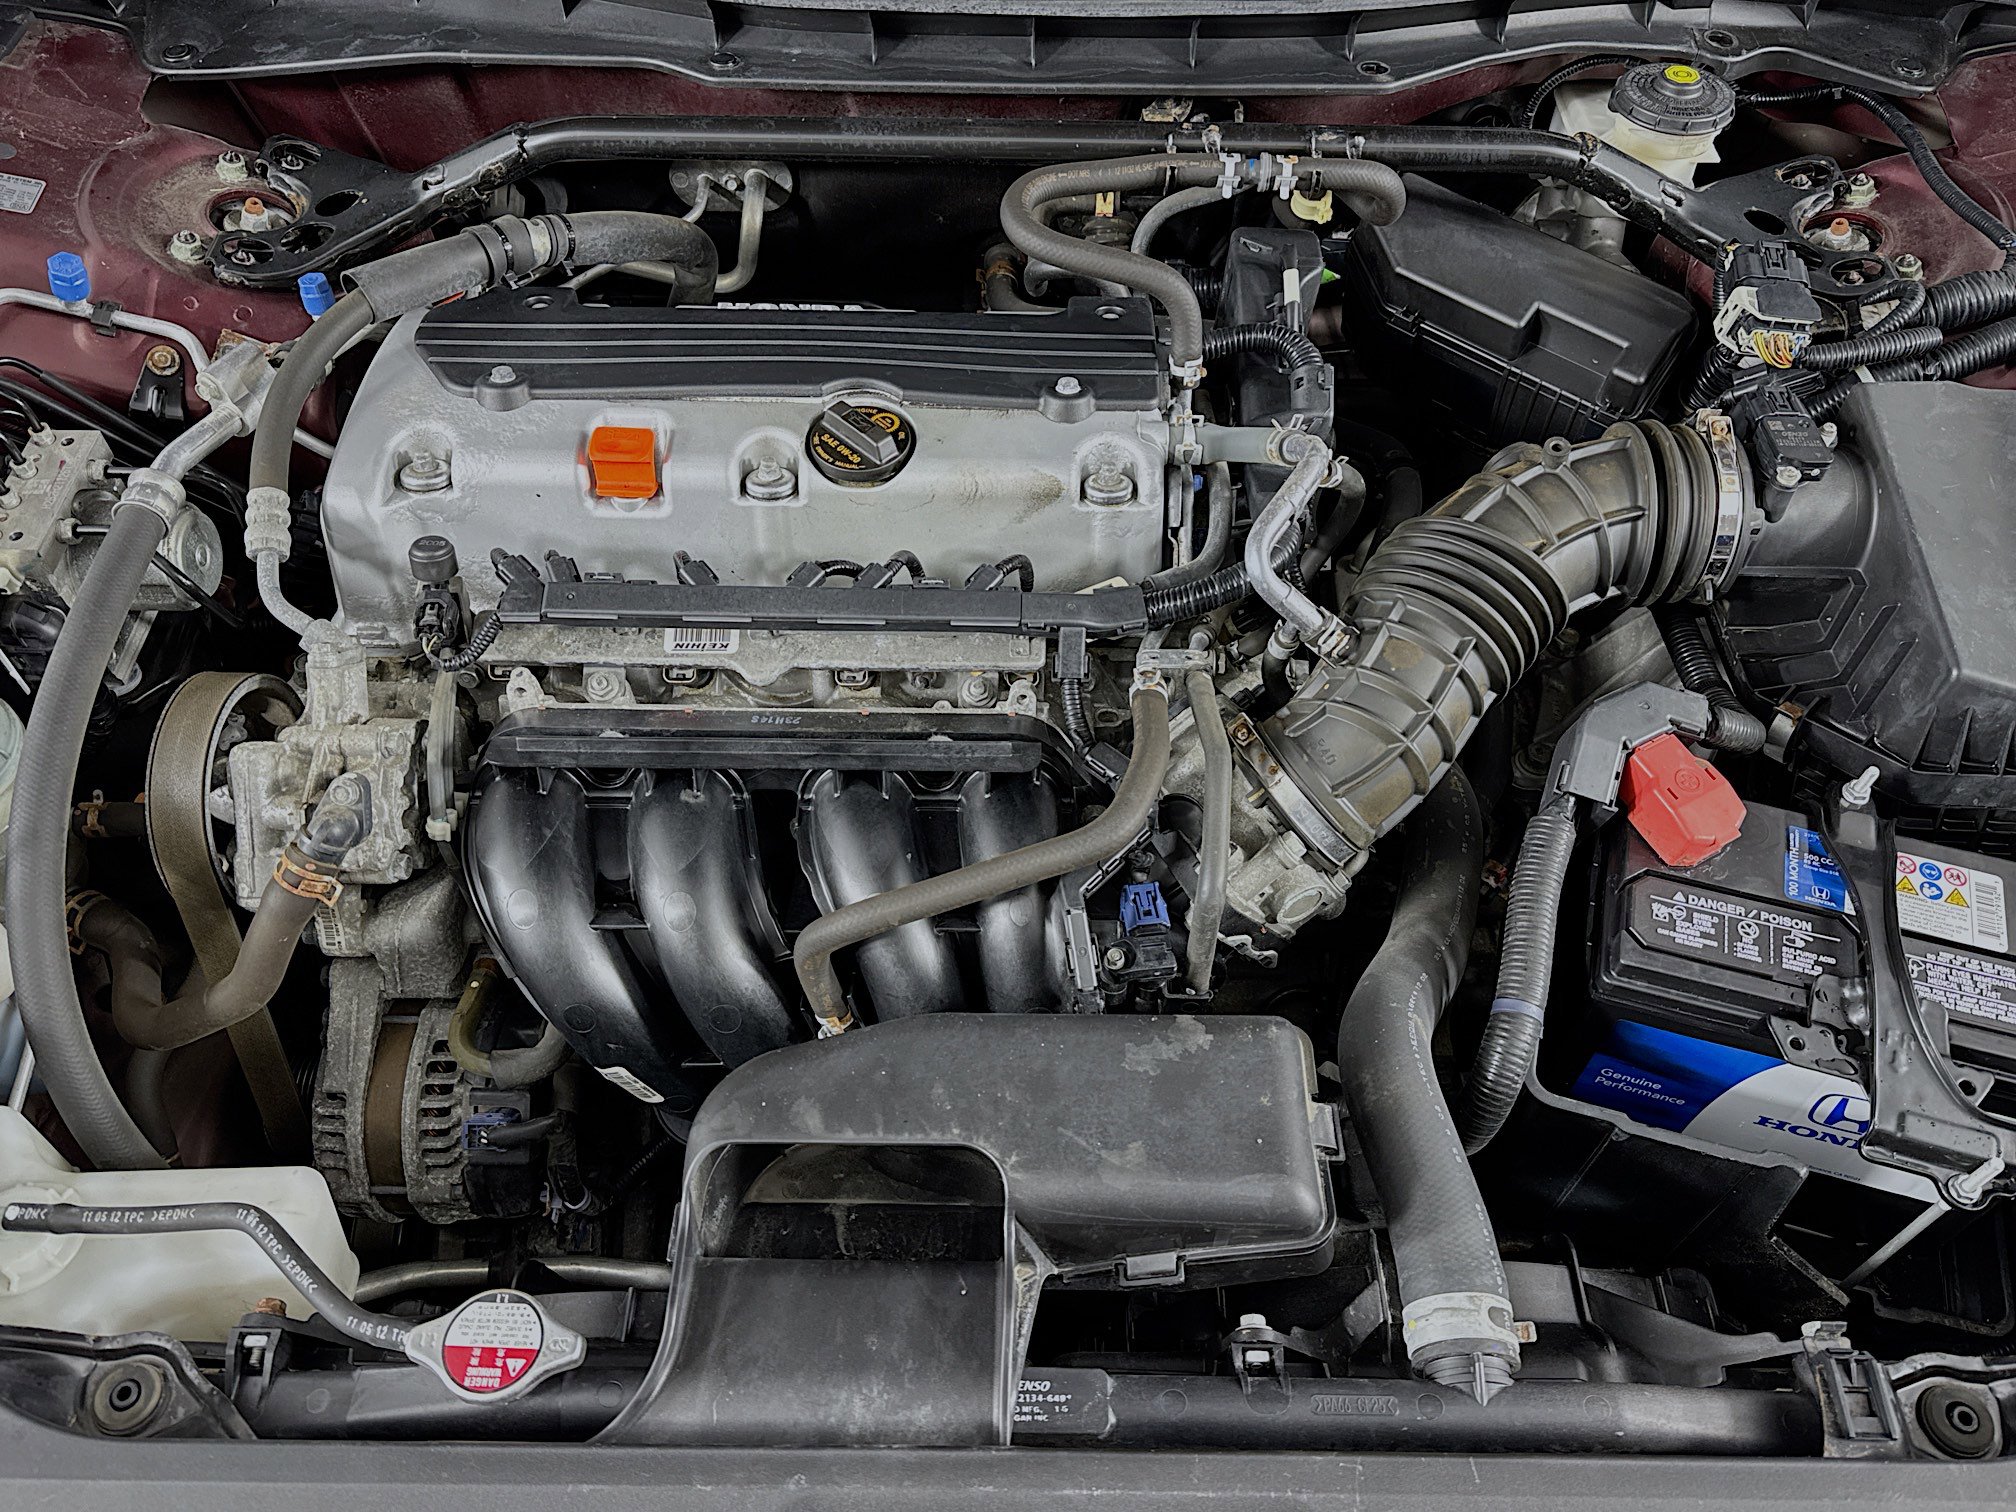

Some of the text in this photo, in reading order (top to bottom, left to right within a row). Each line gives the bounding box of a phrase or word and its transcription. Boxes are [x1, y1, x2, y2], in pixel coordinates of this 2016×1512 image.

[821, 433, 862, 464] SAE 0W-20
[673, 642, 730, 652] KEIHIN
[1789, 846, 1799, 880] MONTH
[1820, 857, 1835, 866] CC
[1789, 882, 1799, 897] 100
[1804, 895, 1837, 908] HONDA
[1688, 895, 1746, 917] DANGER
[1760, 911, 1813, 932] POISON
[1926, 970, 1946, 980] WITH
[1926, 962, 2016, 990] FLUSH EYES IMMEDIATEL
[1927, 977, 1960, 990] MEDICAL
[1961, 984, 1981, 996] HELP
[1982, 989, 2001, 1000] FAST
[1600, 1068, 1662, 1090] Genuine
[1594, 1075, 1686, 1105] Performance
[1753, 1115, 1860, 1150] HON
[17, 1208, 48, 1220] PDM<
[81, 1211, 92, 1223] 11
[94, 1211, 107, 1222] 05
[109, 1211, 120, 1223] 12
[123, 1211, 145, 1223] TPC
[236, 1208, 248, 1220] 11
[255, 1223, 268, 1238] 12
[264, 1233, 283, 1255] TPC
[345, 1315, 406, 1342] 11 05 12 TP
[465, 1366, 502, 1377] WARNING
[463, 1376, 501, 1387] DANGER
[1018, 1380, 1051, 1392] ENSO
